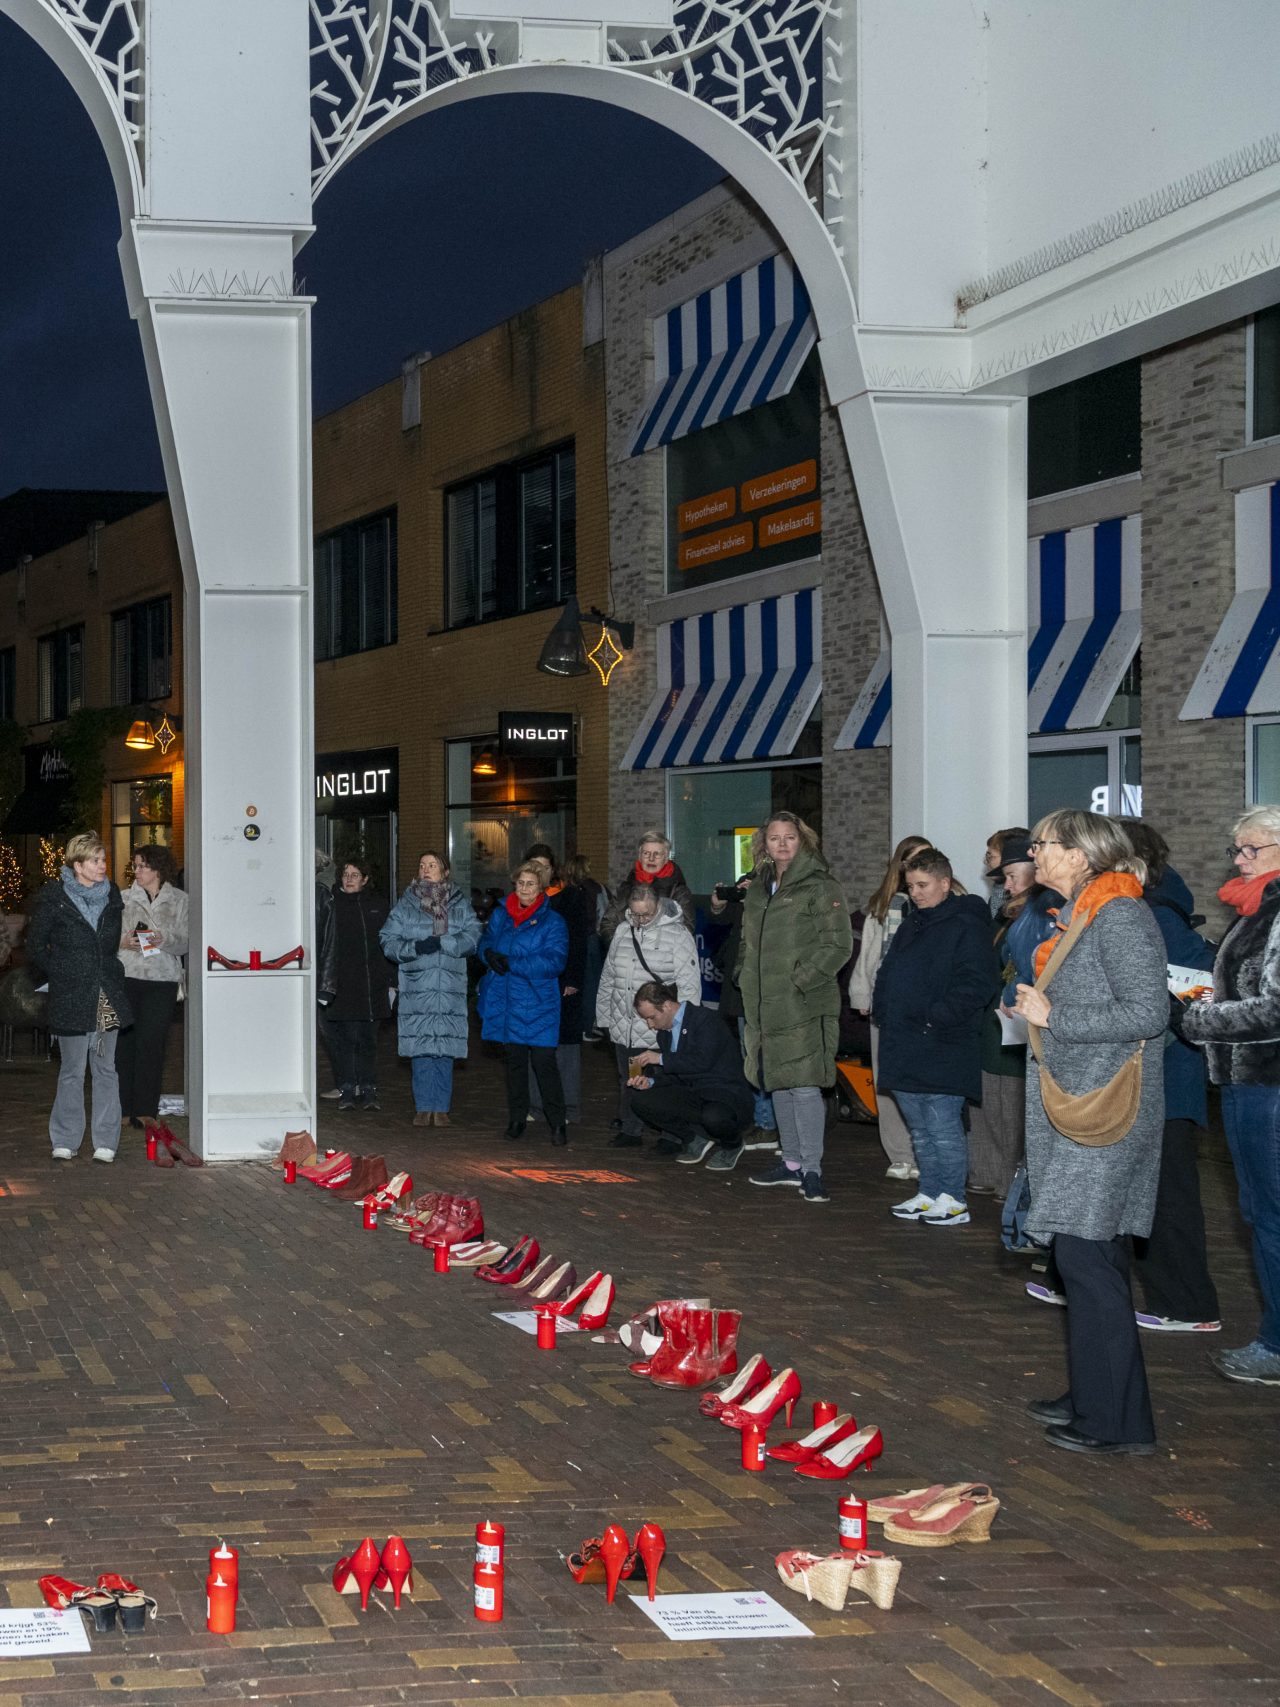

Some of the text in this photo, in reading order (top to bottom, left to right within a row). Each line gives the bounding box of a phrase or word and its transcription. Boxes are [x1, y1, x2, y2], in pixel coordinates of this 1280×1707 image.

[749, 475, 807, 501] Verzekeringen
[685, 501, 728, 524] Hypotheken
[767, 511, 815, 537] Makelaardij
[685, 535, 746, 561] Financieel advies
[508, 728, 568, 741] INGLOT
[317, 769, 391, 799] INGLOT
